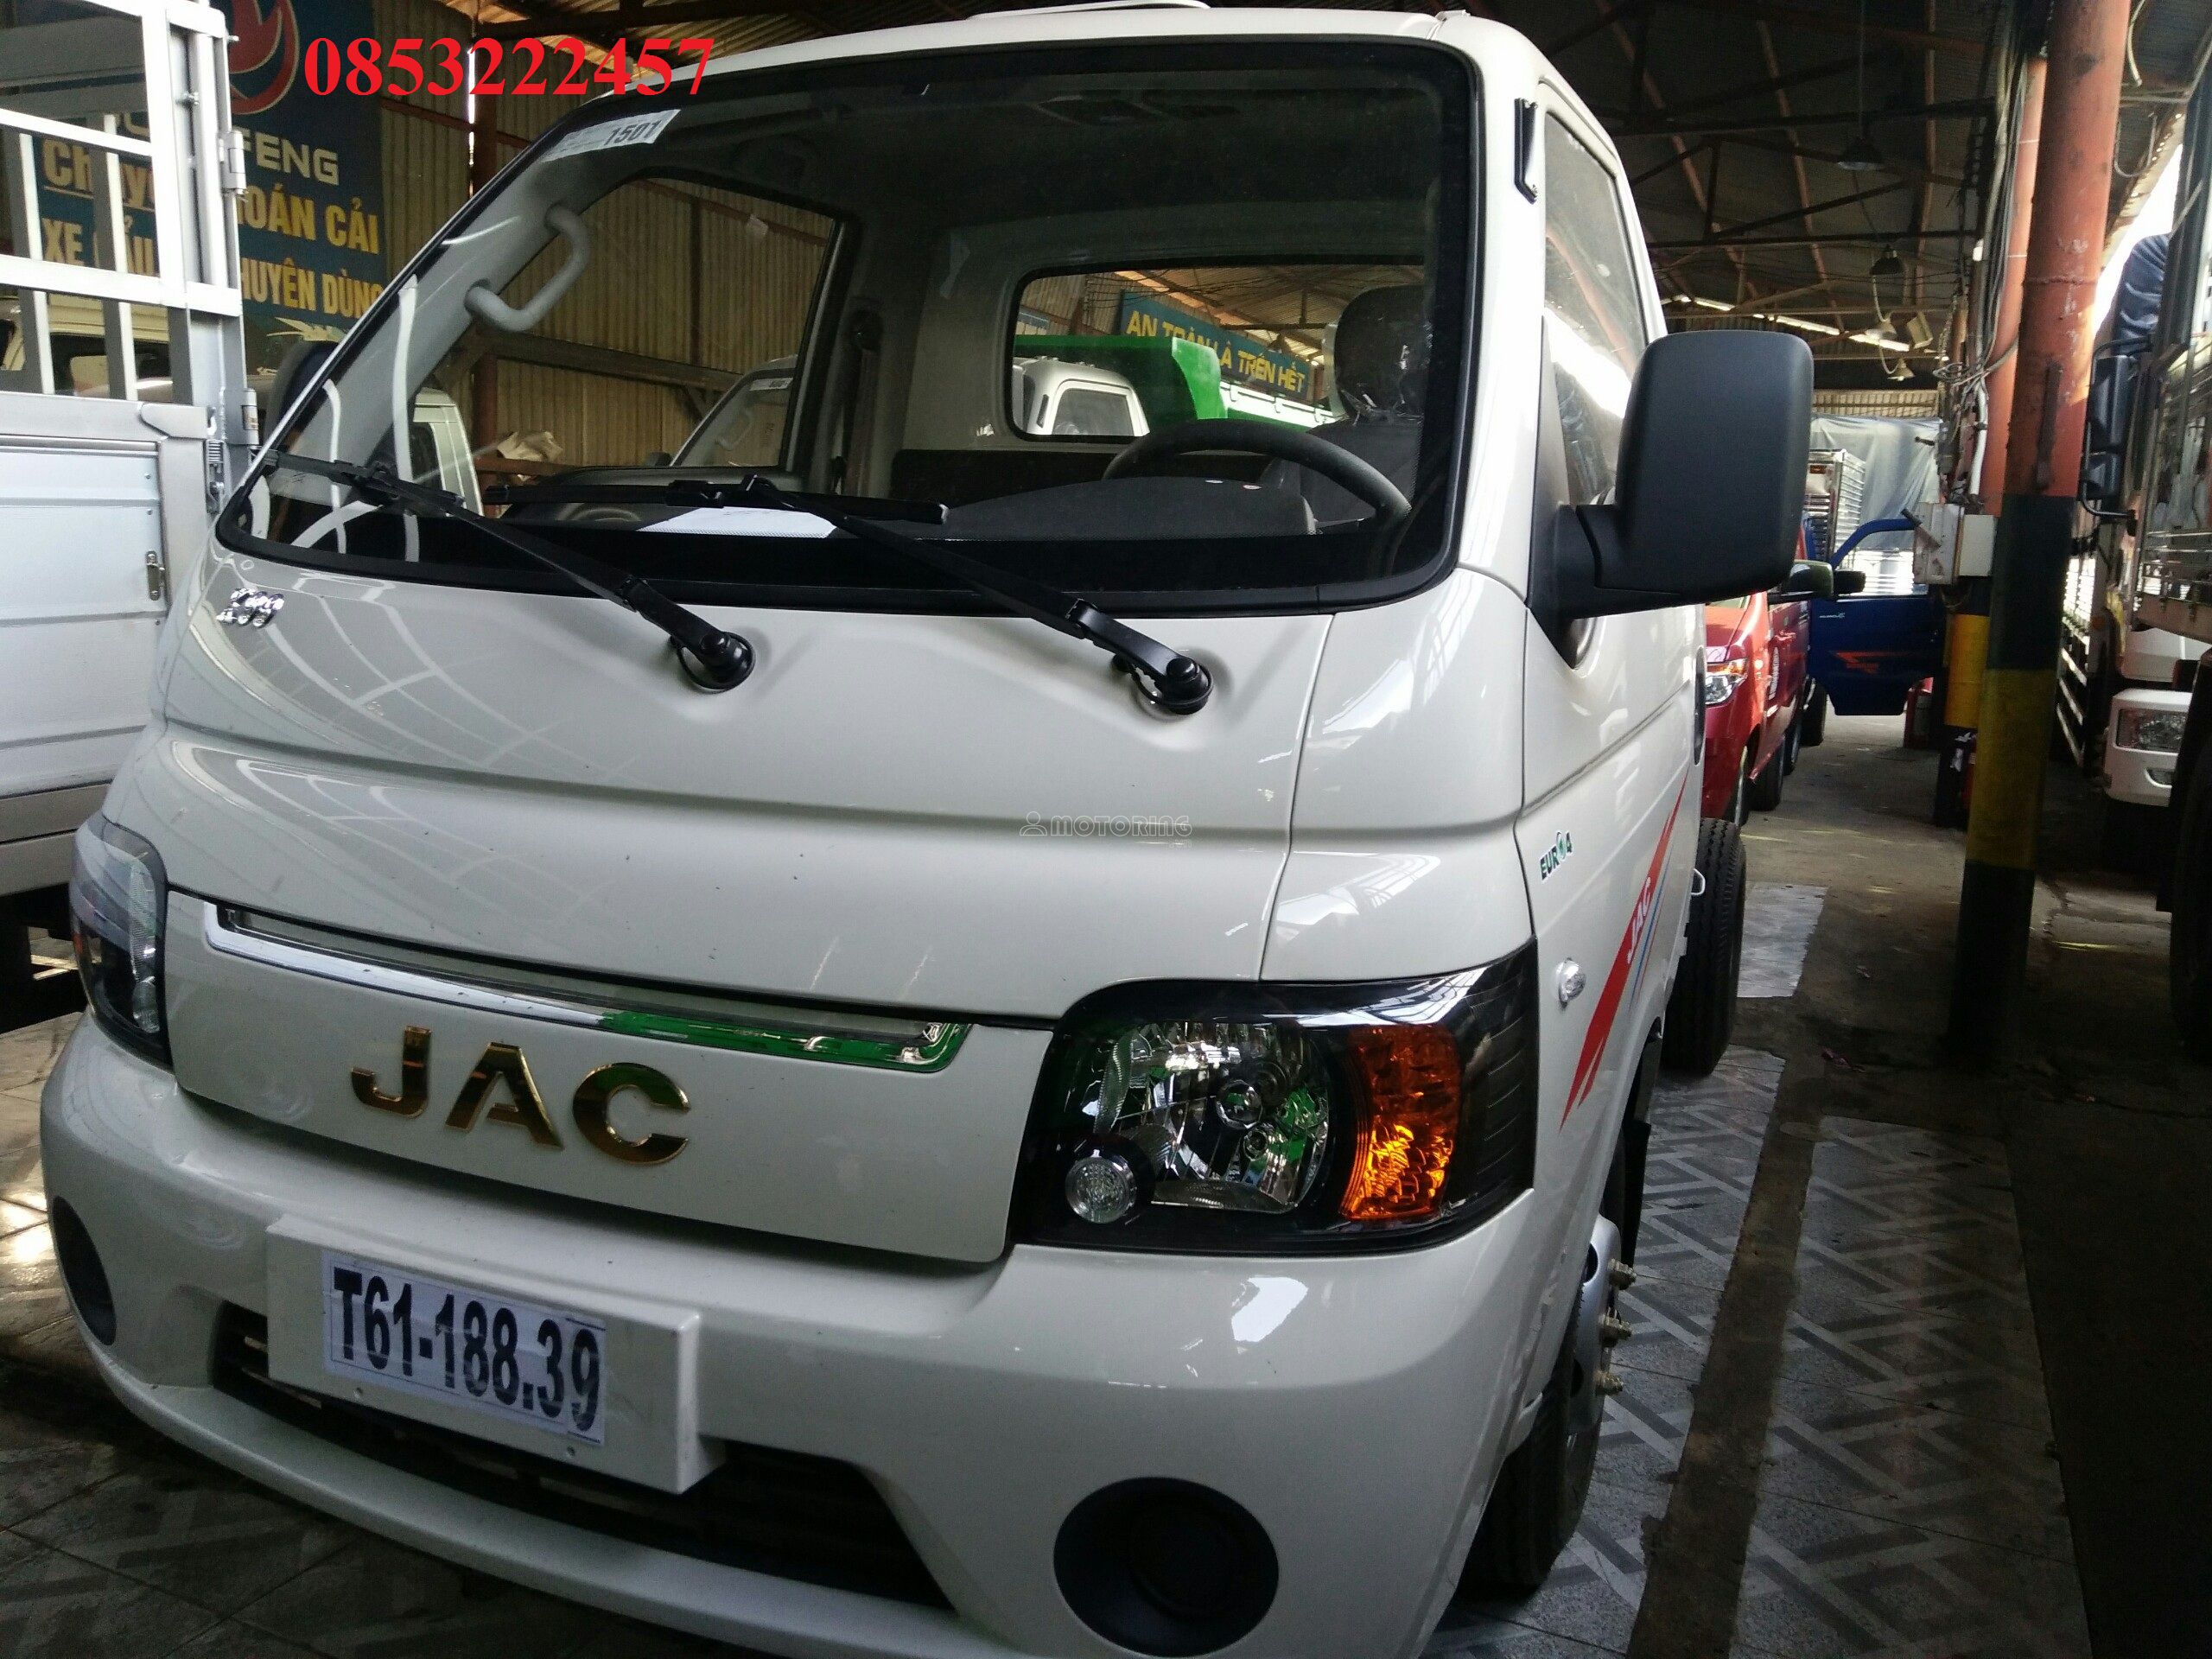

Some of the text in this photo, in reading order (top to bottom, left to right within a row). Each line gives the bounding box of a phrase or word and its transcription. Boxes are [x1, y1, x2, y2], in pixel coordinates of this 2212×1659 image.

[325, 196, 380, 254] CẢI
[1126, 310, 1158, 337] AN
[351, 1025, 690, 1166] JAC
[334, 1267, 601, 1433] T61-188.39
